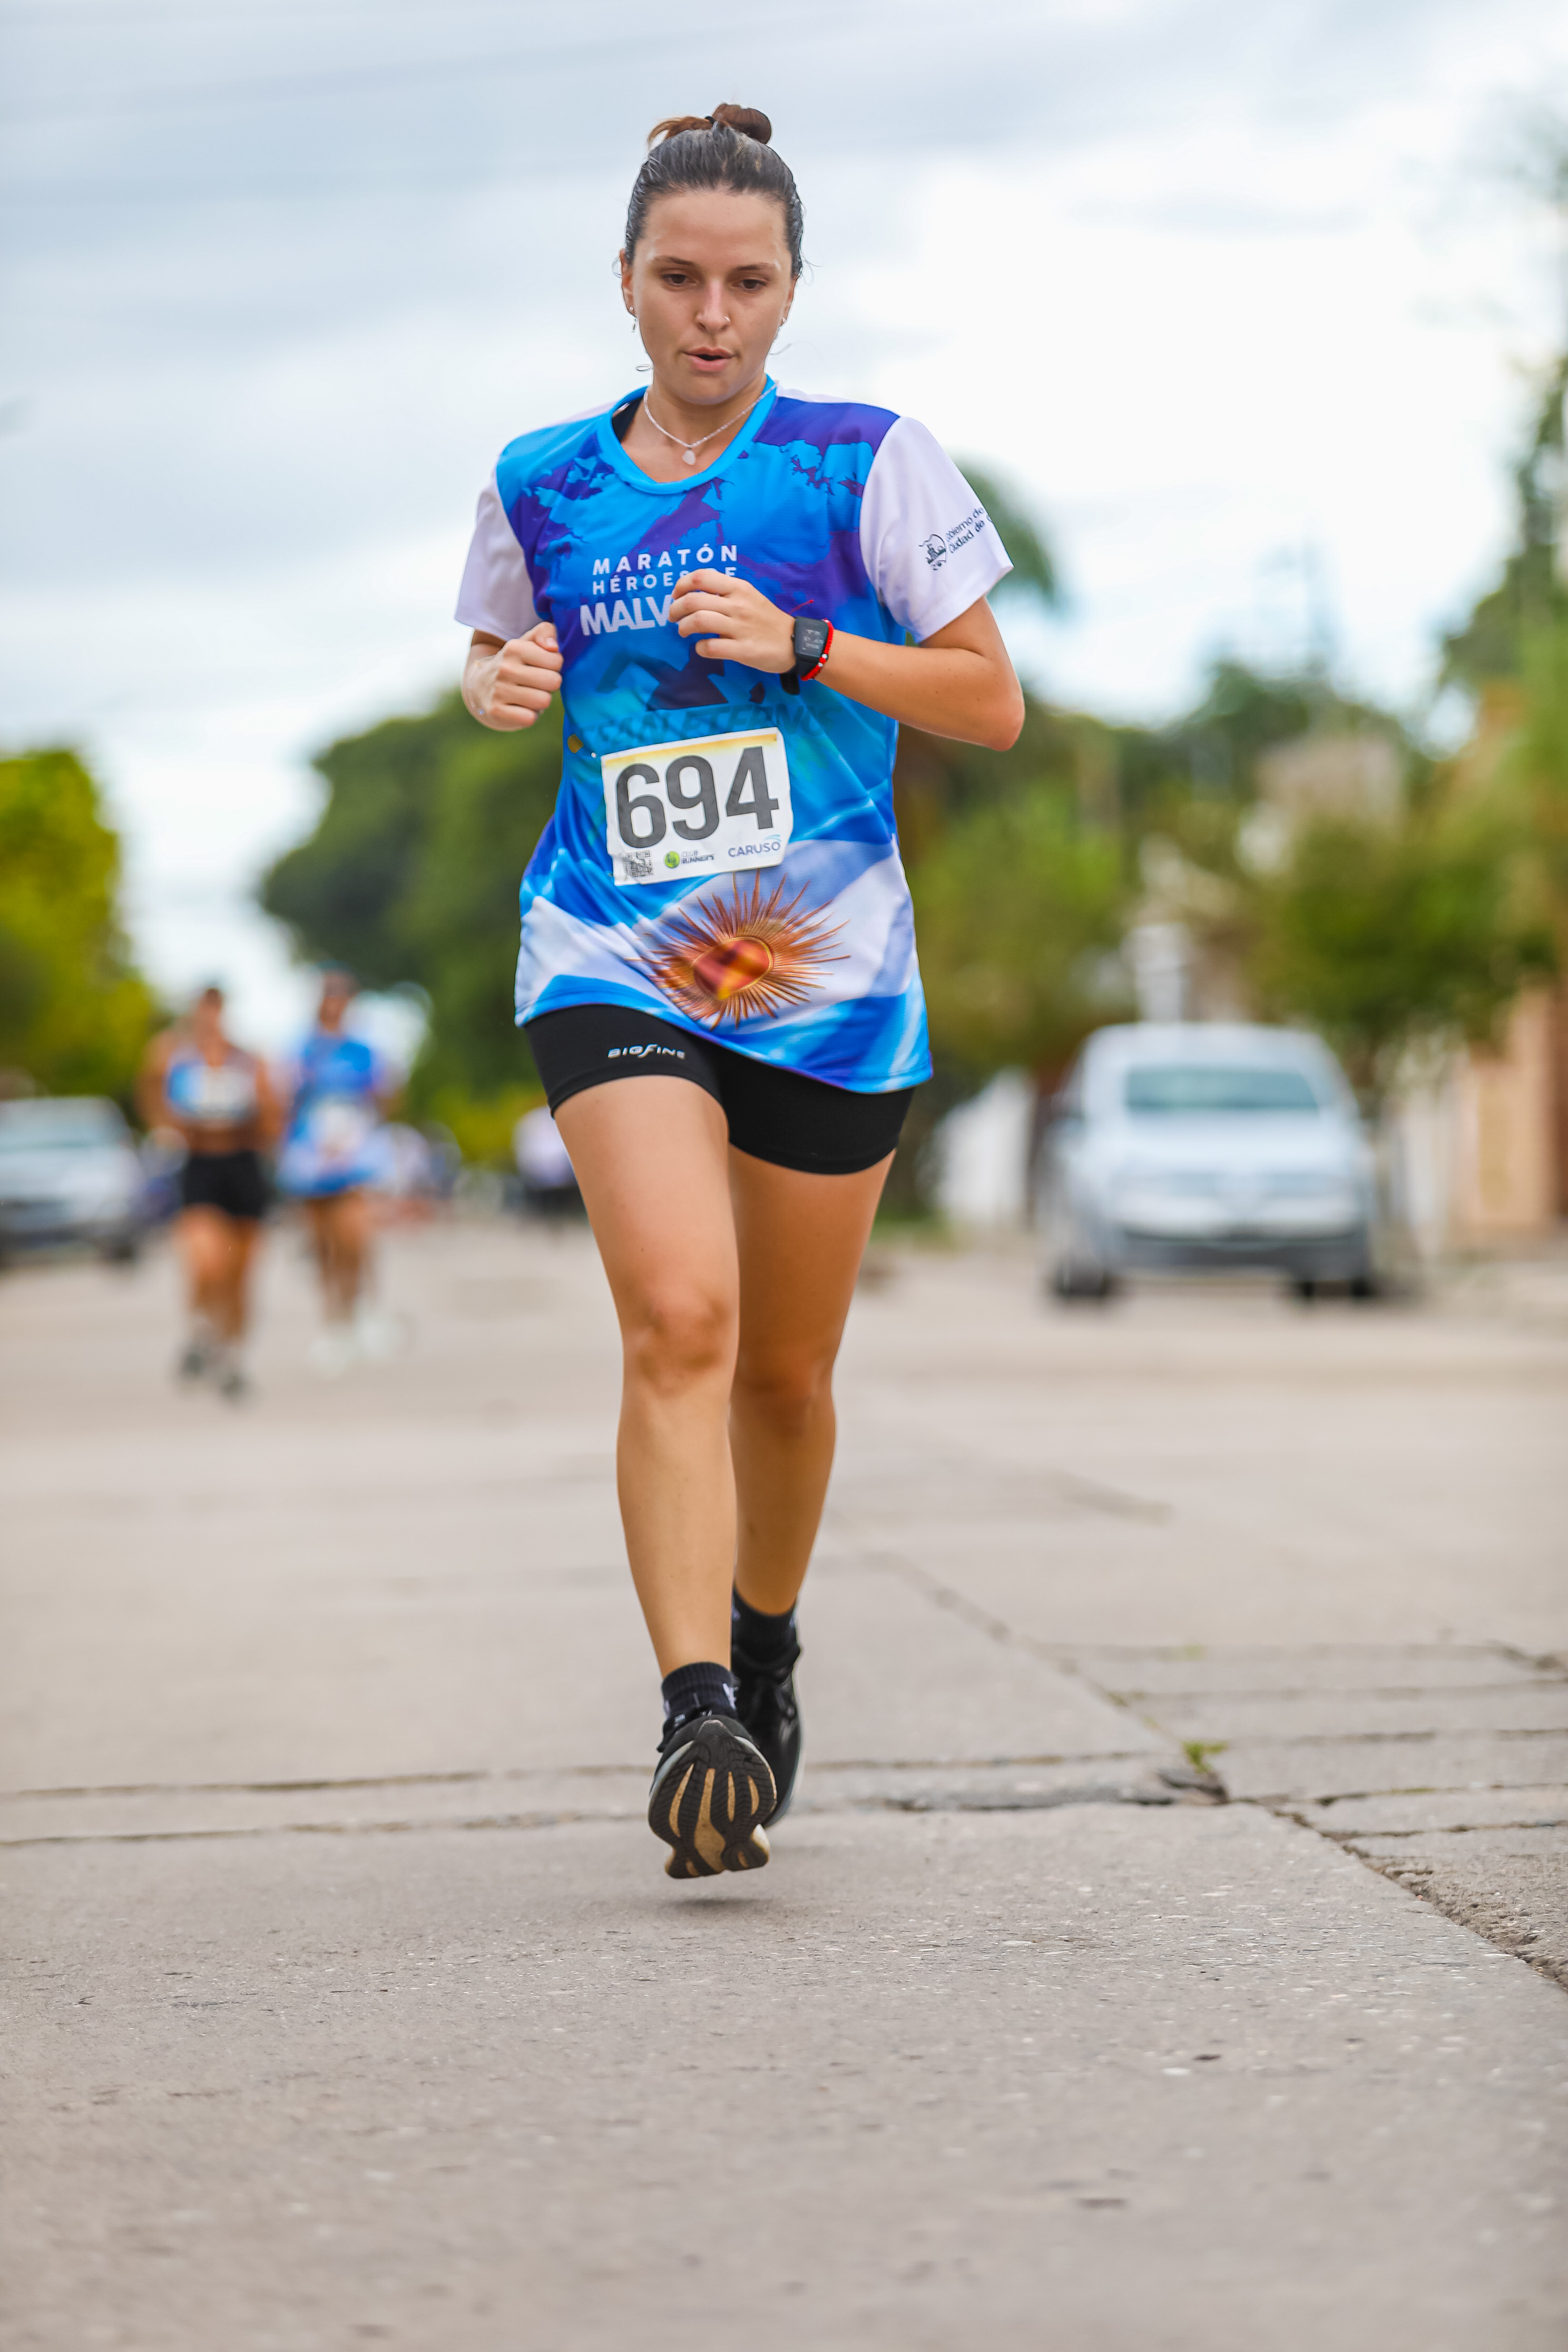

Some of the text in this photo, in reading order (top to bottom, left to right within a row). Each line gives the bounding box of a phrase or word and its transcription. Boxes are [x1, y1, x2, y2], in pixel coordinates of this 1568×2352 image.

[592, 543, 737, 576] MARATÓN
[580, 594, 674, 636] MALV
[616, 746, 779, 849] 694
[728, 842, 780, 857] CARUSO
